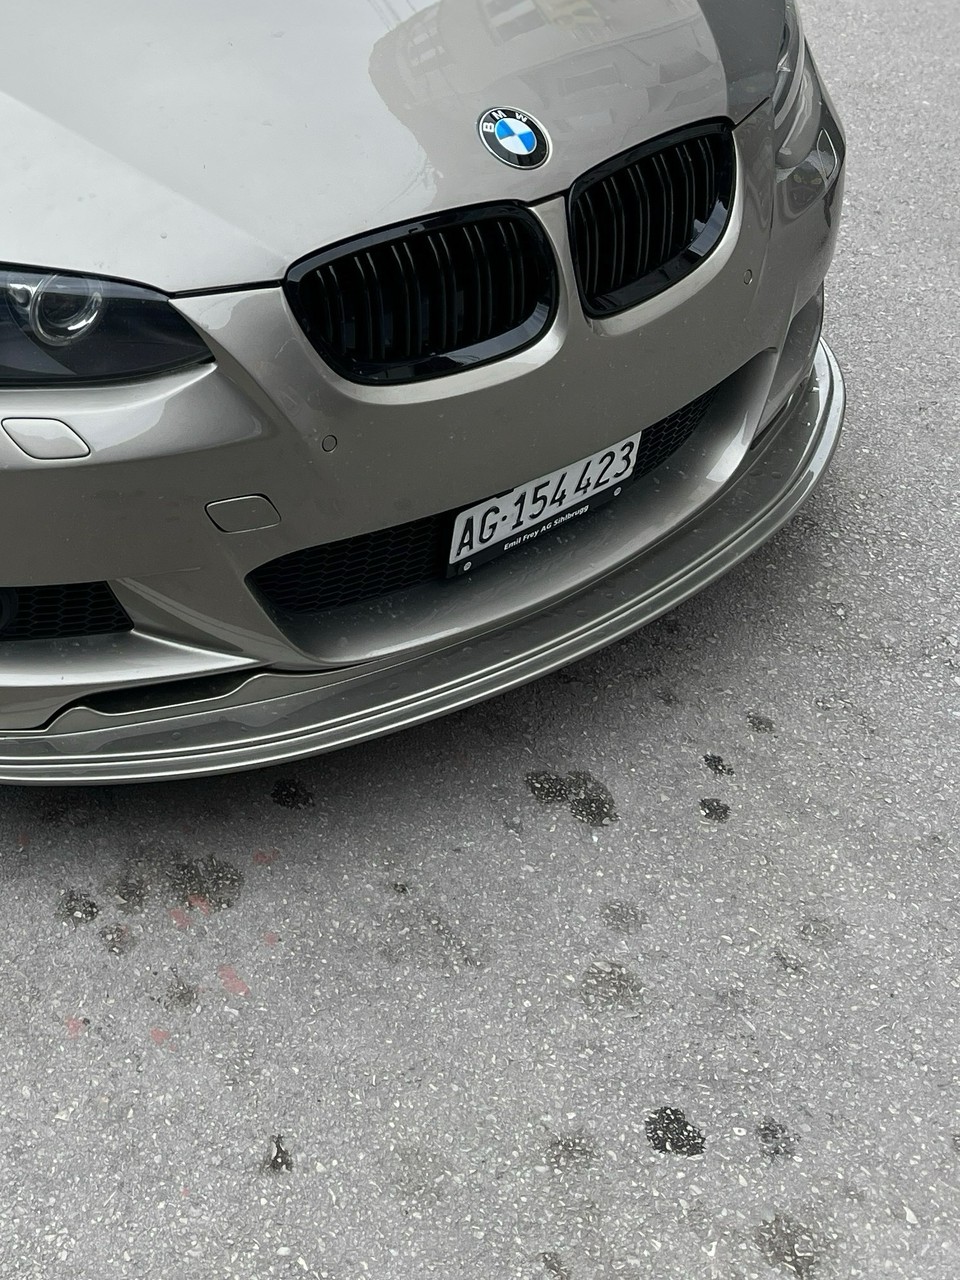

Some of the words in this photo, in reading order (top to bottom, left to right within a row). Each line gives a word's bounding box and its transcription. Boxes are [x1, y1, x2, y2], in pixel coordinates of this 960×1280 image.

[482, 109, 528, 133] BMW
[574, 441, 635, 495] 423
[503, 536, 522, 551] Emil
[522, 529, 540, 542] Frey
[540, 522, 552, 533] AG
[553, 504, 589, 527] Sihlbrugg
